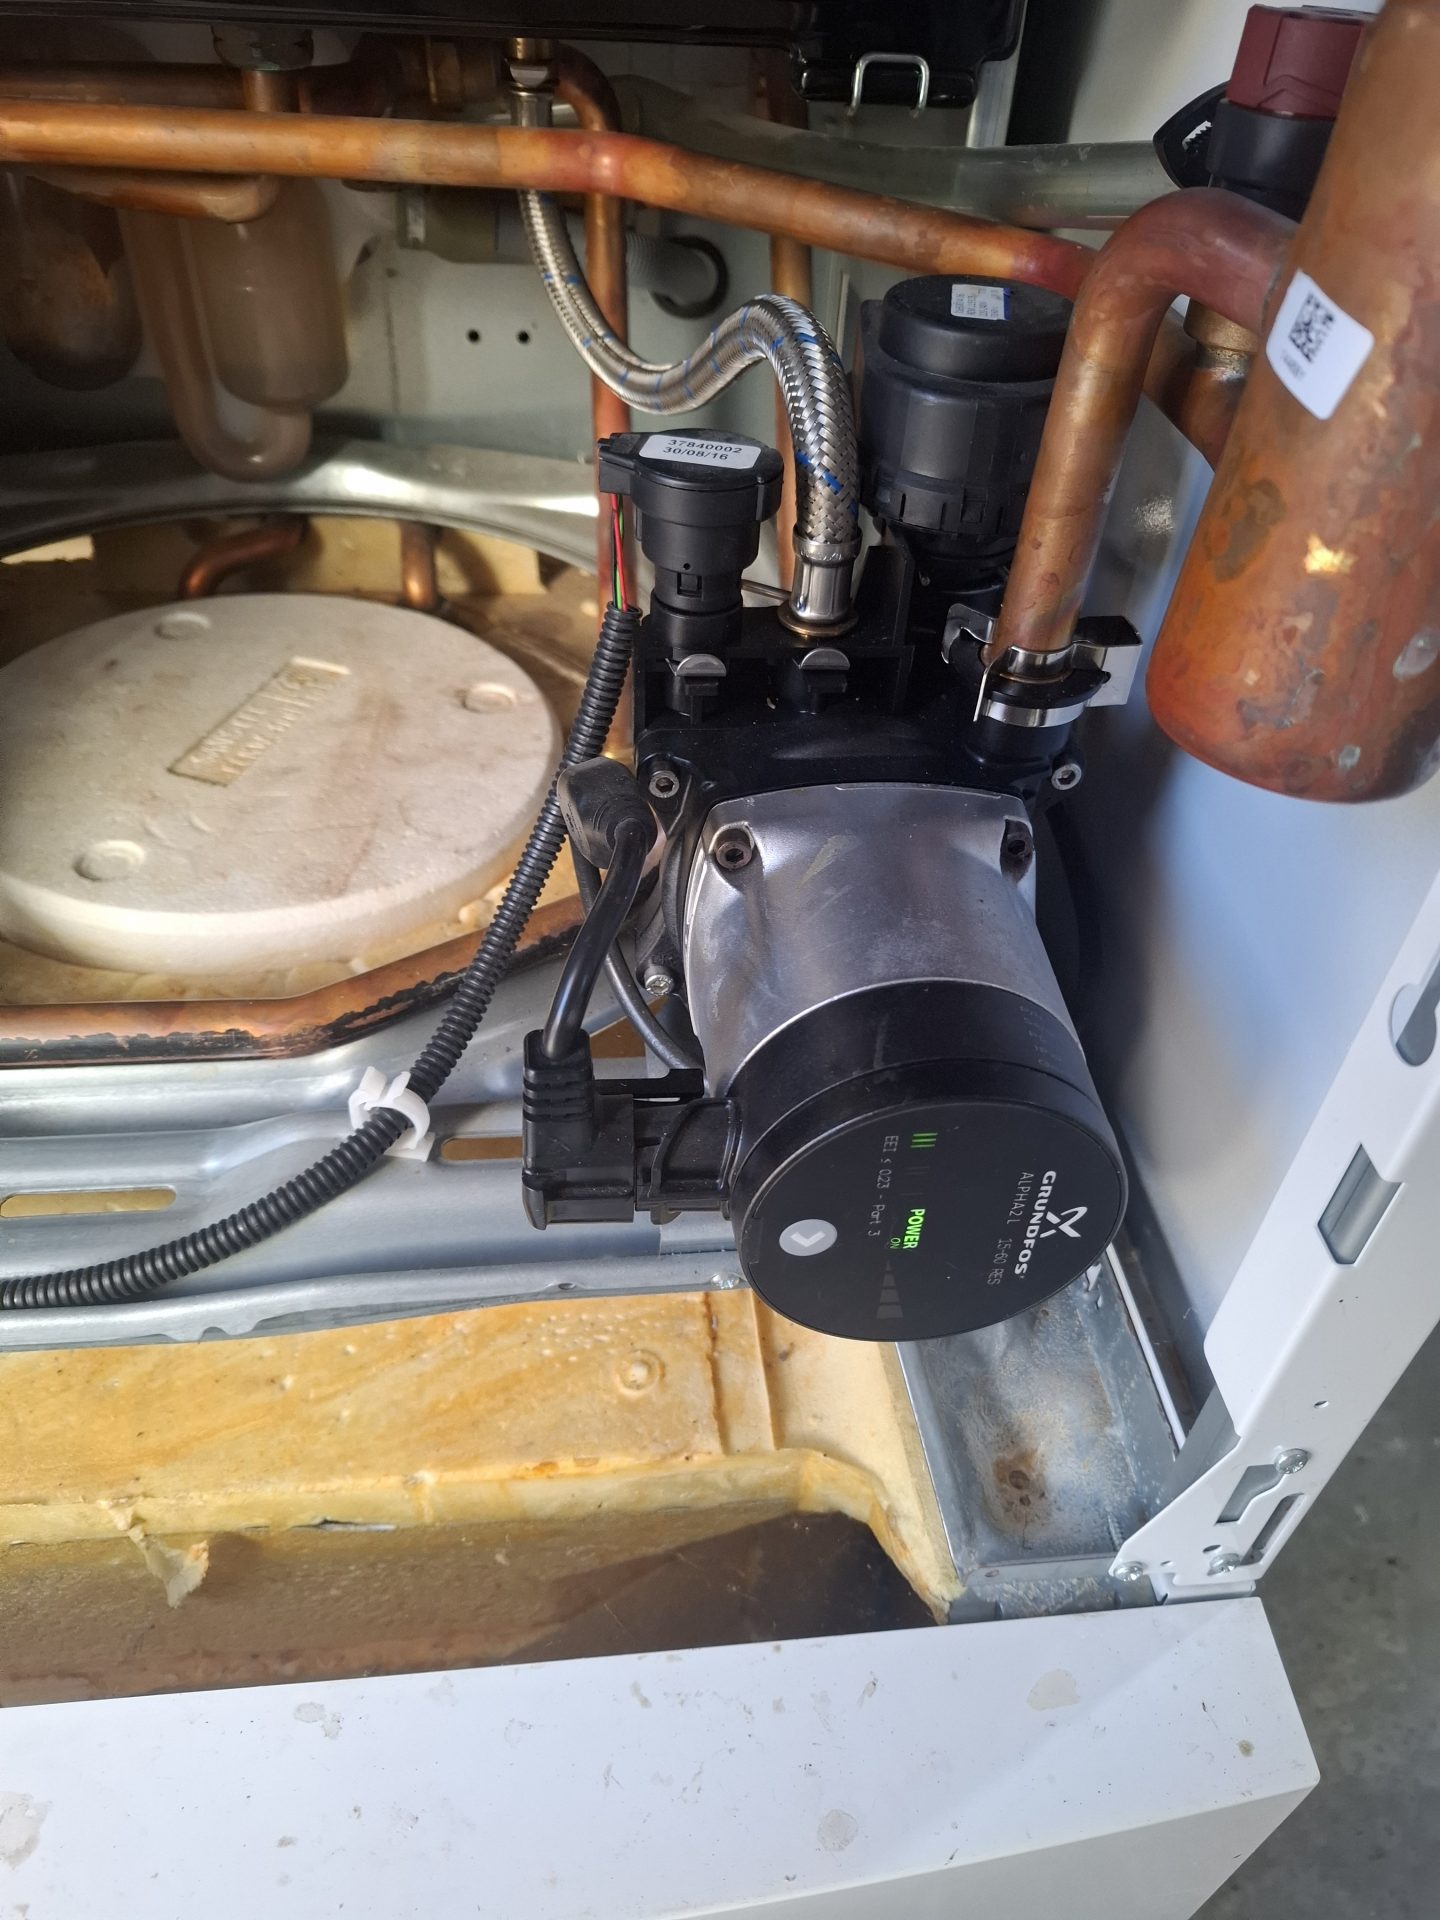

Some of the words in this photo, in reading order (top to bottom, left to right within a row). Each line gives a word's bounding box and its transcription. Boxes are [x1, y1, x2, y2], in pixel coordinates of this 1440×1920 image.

[663, 446, 728, 461] 30/08/16
[668, 439, 742, 454] 37840002
[882, 1135, 899, 1152] EEI
[1009, 1171, 1035, 1217] ALPHA2
[869, 1204, 886, 1225] Part
[1014, 1170, 1057, 1275] GRUNDFOS
[903, 1208, 926, 1249] POWER
[889, 1237, 901, 1249] ON
[993, 1238, 1013, 1265] 15-60
[987, 1268, 1005, 1285] RES
